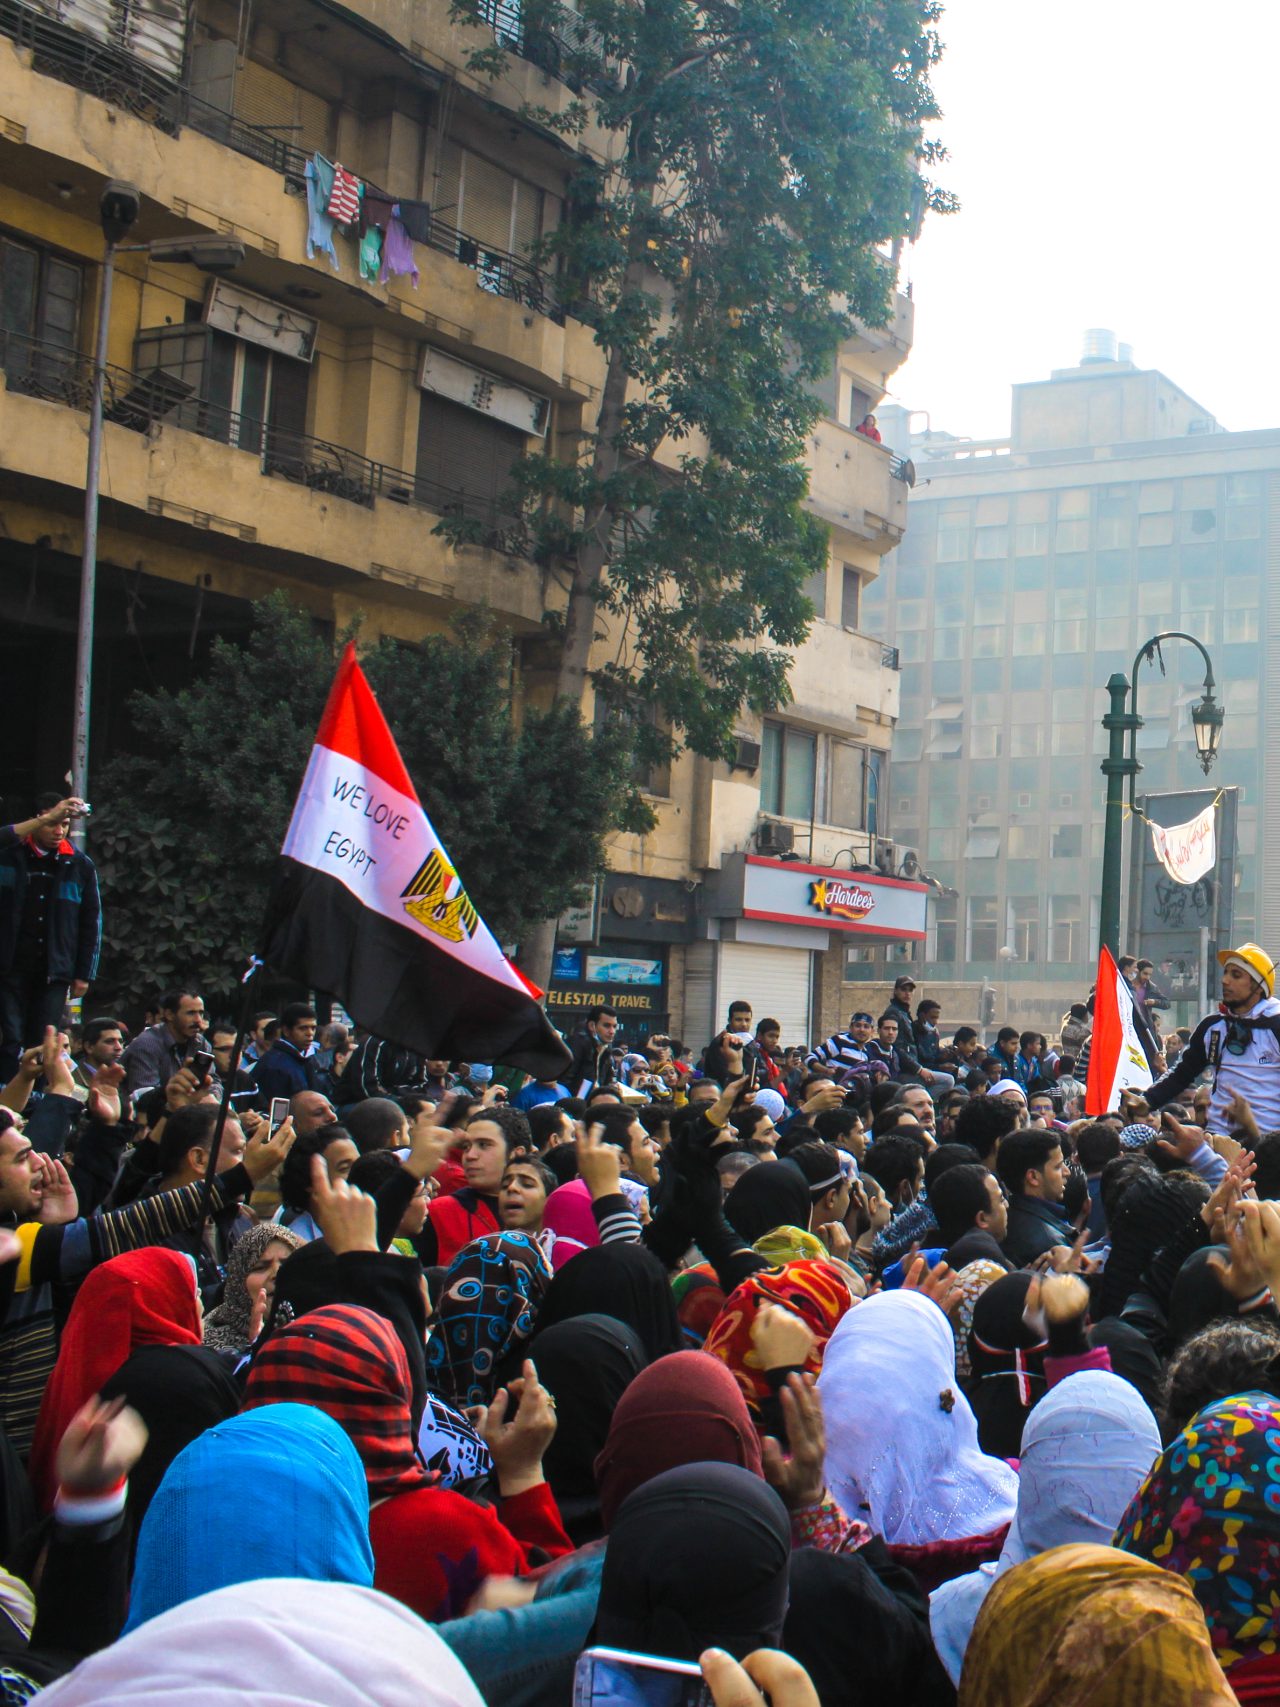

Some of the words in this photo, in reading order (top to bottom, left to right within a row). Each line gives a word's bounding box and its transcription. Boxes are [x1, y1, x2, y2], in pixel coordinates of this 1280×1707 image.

[333, 777, 366, 809] WE
[364, 795, 410, 840] LOVE
[324, 831, 377, 876] EGYPT
[825, 884, 875, 909] Hardee's
[547, 991, 605, 1006] ELESTAR
[611, 994, 652, 1009] TRAVEL
